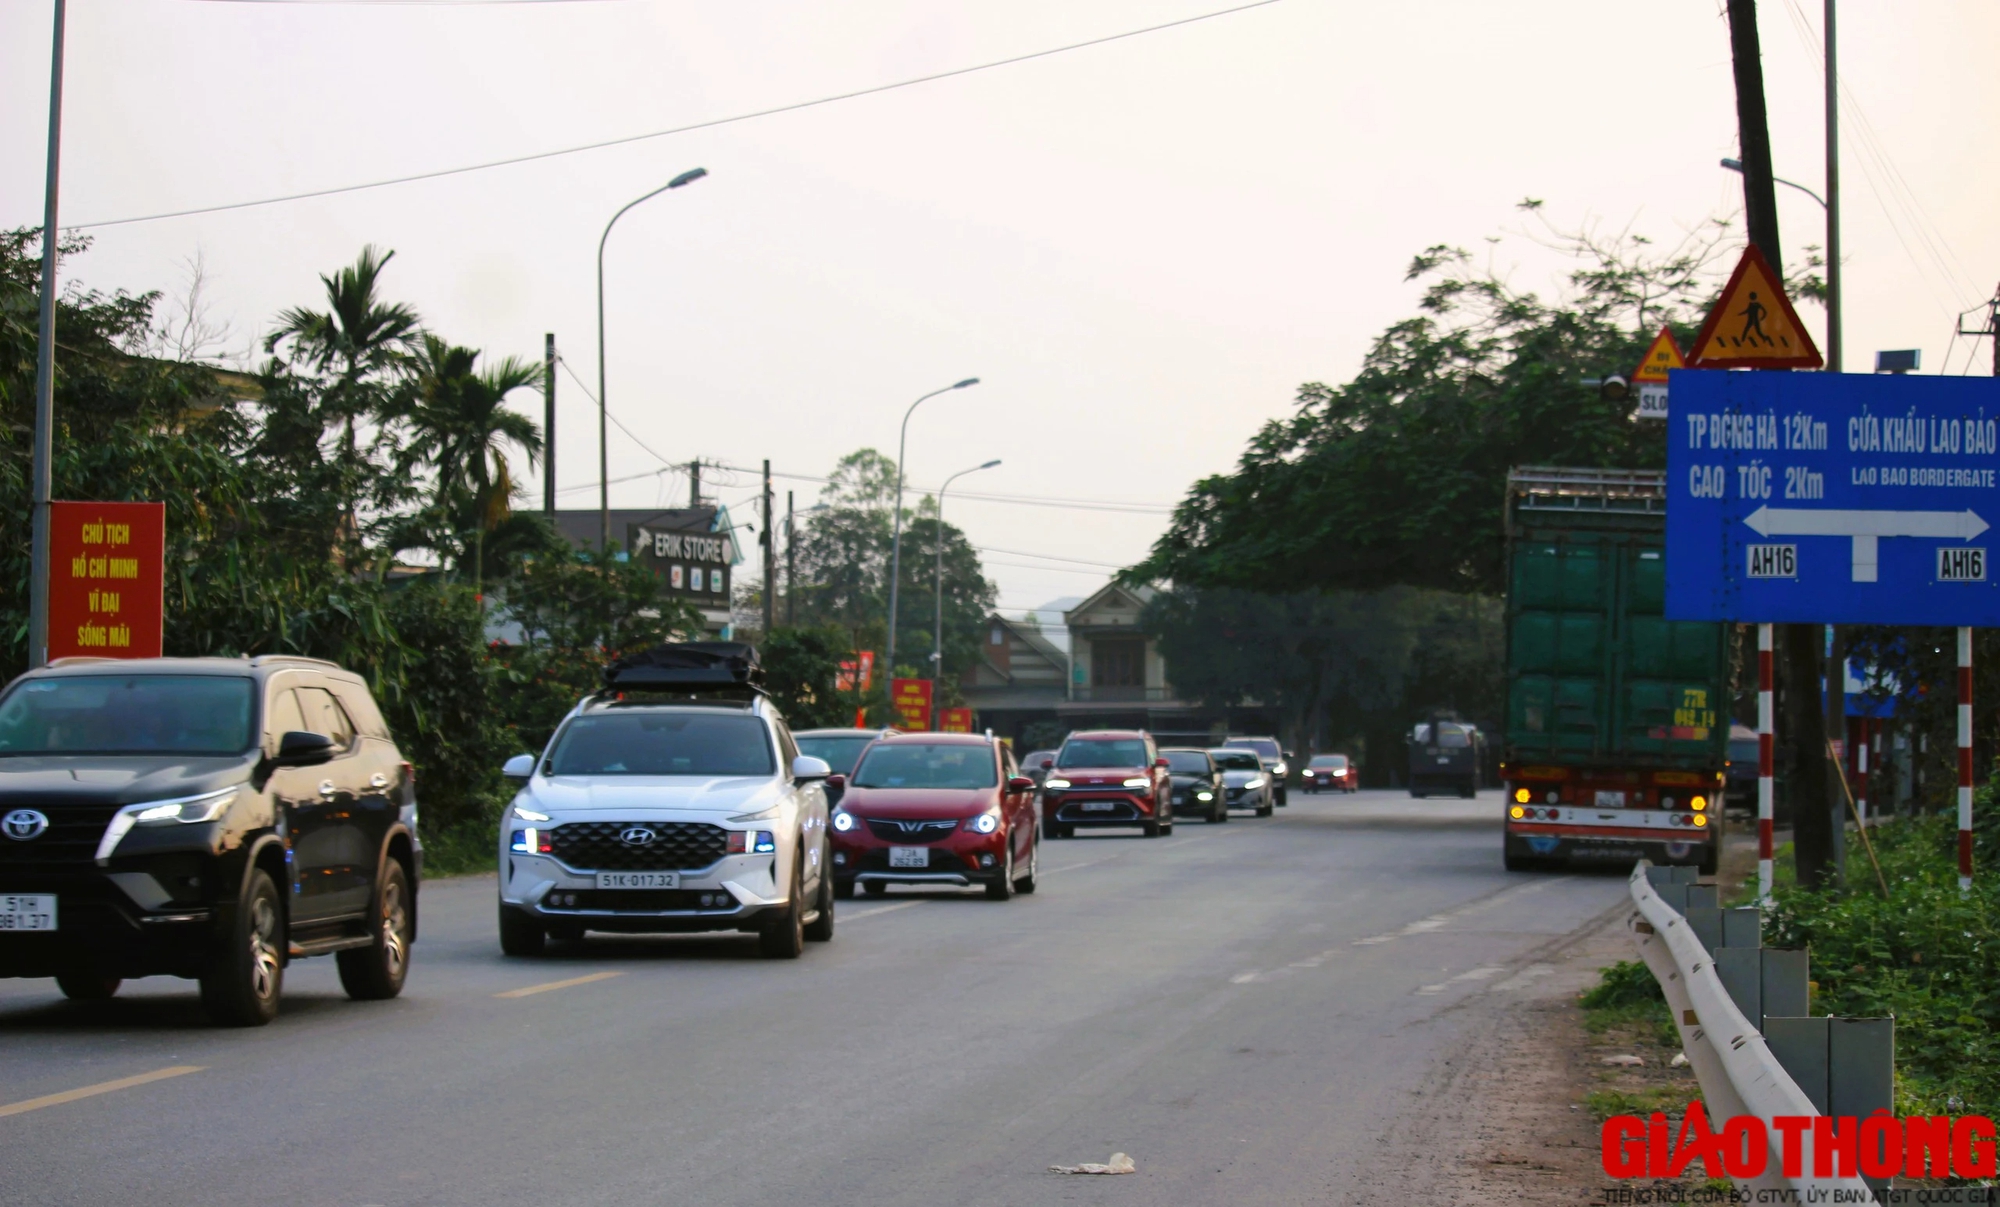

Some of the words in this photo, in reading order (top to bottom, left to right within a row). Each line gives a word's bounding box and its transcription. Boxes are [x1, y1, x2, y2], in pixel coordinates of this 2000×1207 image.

[1642, 394, 1668, 411] SLO
[1687, 413, 1707, 449] TP
[1756, 408, 1778, 450] HÀ
[1782, 414, 1828, 450] 12Km
[1848, 404, 1881, 452] CỬA
[1883, 405, 1926, 453] KHẨU
[1930, 418, 1960, 454] LAO
[1965, 406, 1996, 455] BẢO
[1689, 464, 1725, 499] CAO
[1738, 459, 1772, 499] TỐC
[1785, 466, 1824, 499] 2Km
[1852, 467, 1877, 486] LAO
[1881, 467, 1908, 486] BAO
[1910, 467, 1996, 488] BORDERGATE
[82, 517, 103, 545] CHỦ
[106, 524, 130, 549] TỊCH
[655, 533, 682, 558] ERIK
[684, 535, 722, 563] STORE
[1751, 547, 1794, 575] AH16
[89, 553, 107, 579] CHÍ
[109, 558, 138, 580] MINH
[1941, 550, 1982, 578] AH16
[88, 587, 99, 612] VĨ
[101, 591, 120, 617] ĐẠI
[77, 620, 107, 647] SỐNG
[109, 622, 130, 648] MÃI
[603, 874, 673, 887] 51K-017.32
